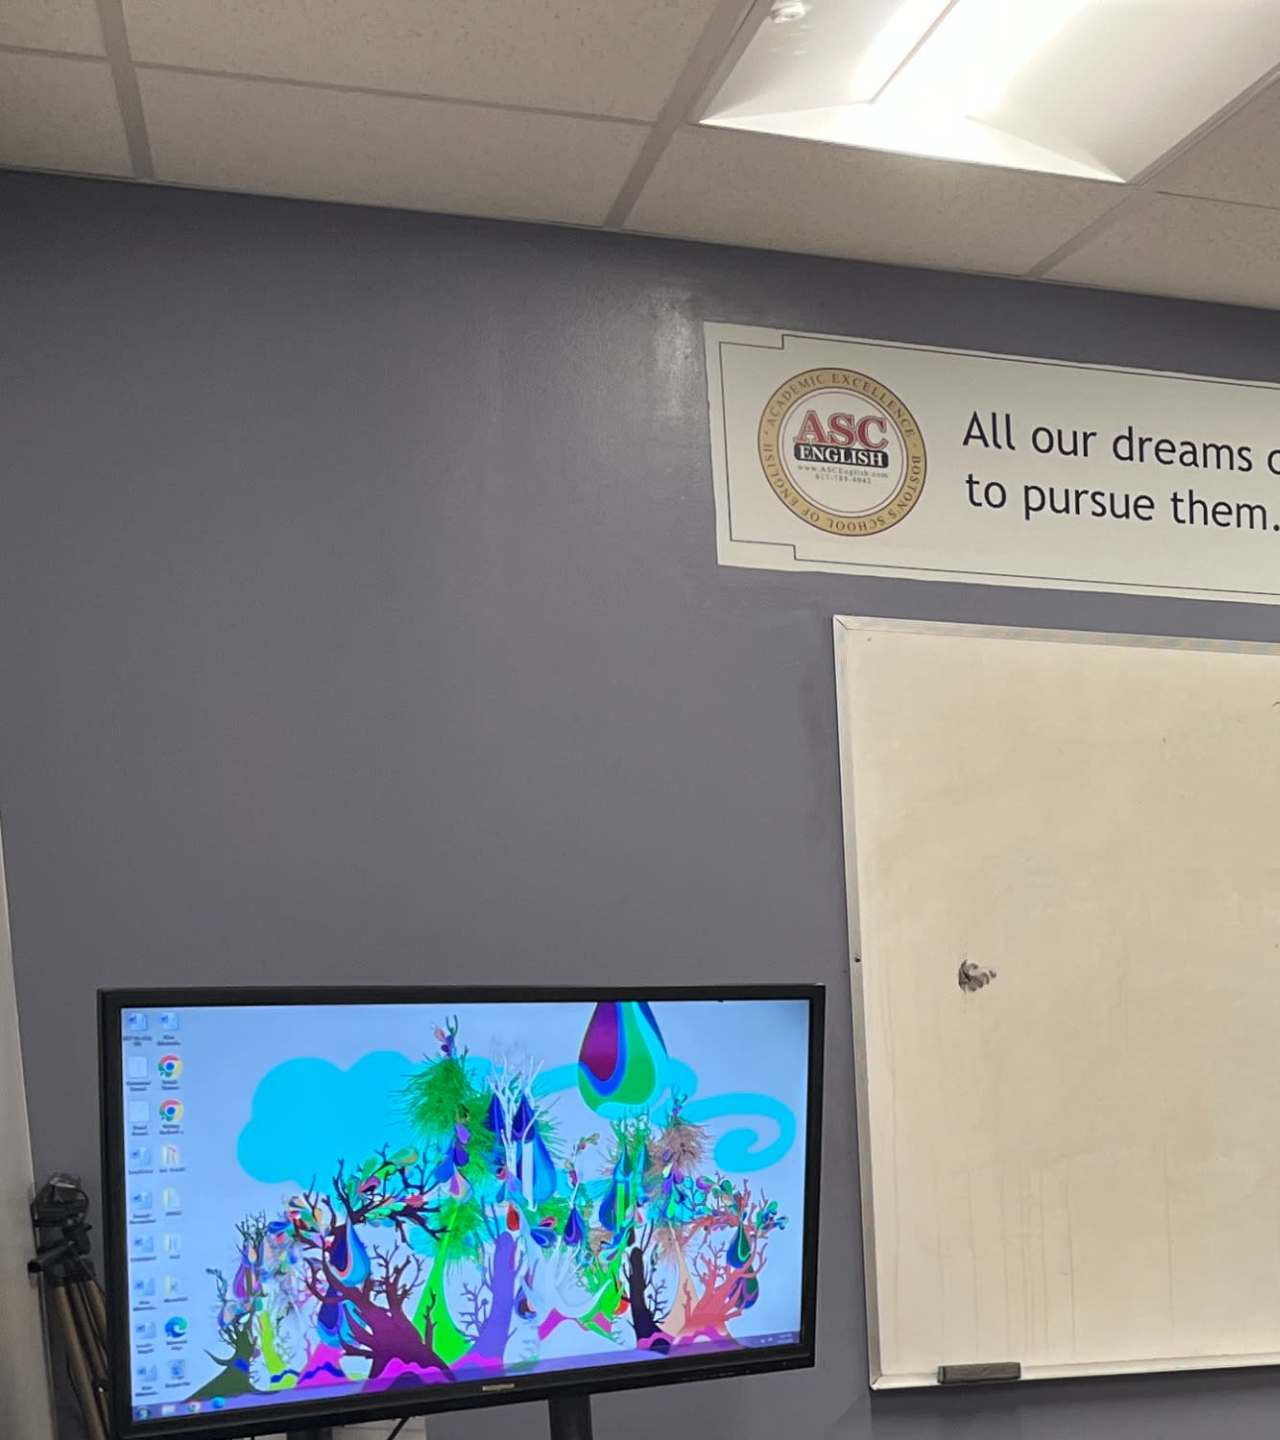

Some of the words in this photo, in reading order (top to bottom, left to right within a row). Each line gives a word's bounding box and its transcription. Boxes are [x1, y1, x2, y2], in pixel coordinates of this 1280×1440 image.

[766, 373, 827, 427] ACADEMIC
[831, 373, 916, 435] EXCELLENCE
[792, 410, 889, 450] ASC
[961, 410, 1017, 452] All
[1031, 426, 1098, 458] our
[1112, 425, 1254, 473] dreams
[762, 443, 801, 505] ENGLISH
[799, 445, 884, 467] ENGLISH
[802, 506, 820, 522] OF
[828, 515, 887, 532] SCHOOL
[964, 472, 1007, 509] to
[1023, 484, 1156, 522] pursue
[1169, 488, 1280, 532] them.
